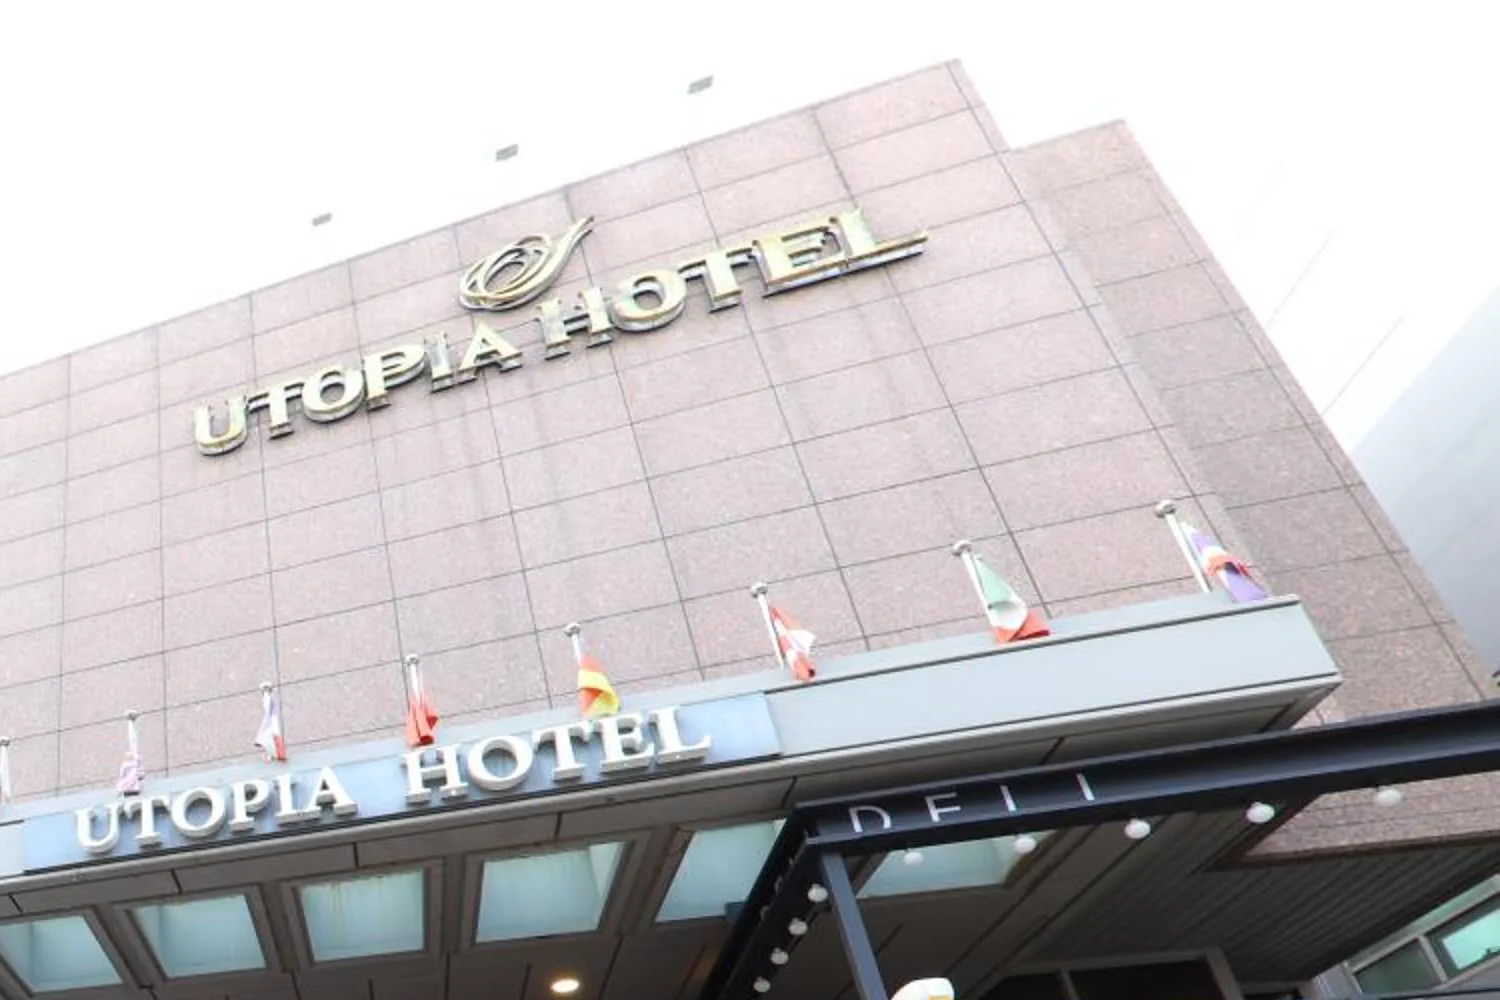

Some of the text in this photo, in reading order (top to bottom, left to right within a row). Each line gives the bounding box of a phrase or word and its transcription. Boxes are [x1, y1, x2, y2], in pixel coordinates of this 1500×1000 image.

[192, 207, 930, 457] UTOPIA HOTEL
[74, 705, 712, 854] UTOPIA HOTEL
